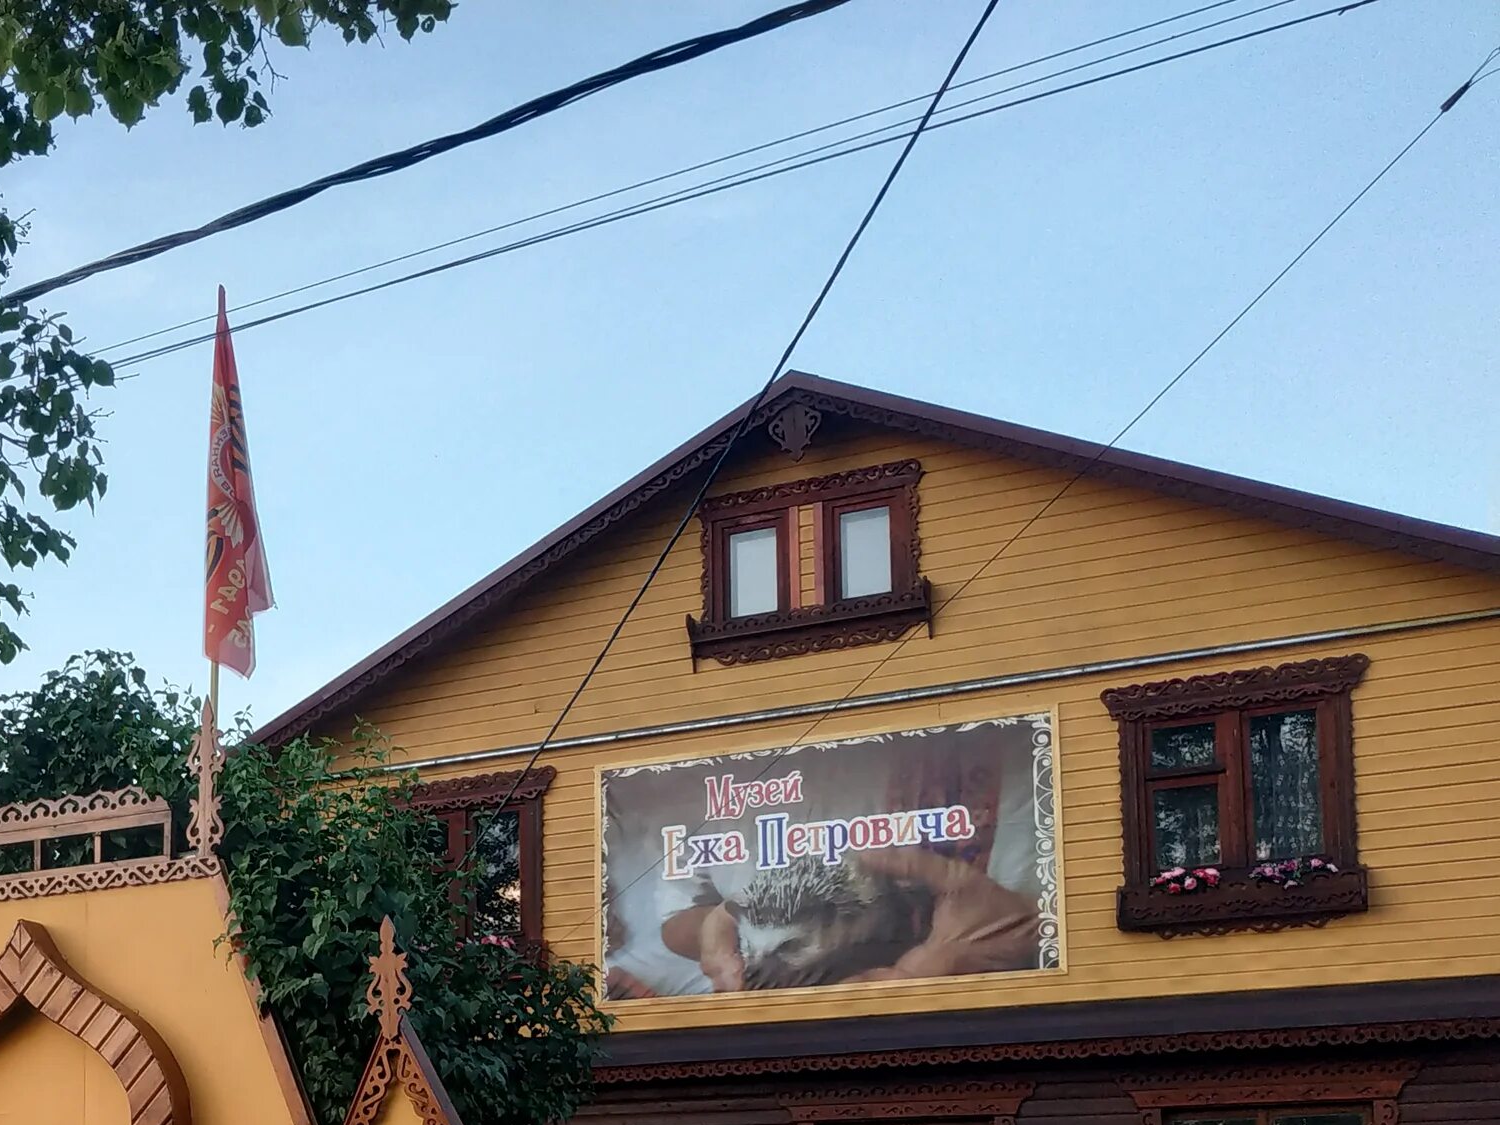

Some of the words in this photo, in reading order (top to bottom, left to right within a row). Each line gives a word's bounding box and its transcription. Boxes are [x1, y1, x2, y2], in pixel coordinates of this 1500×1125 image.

[705, 770, 803, 821] Музей
[662, 825, 749, 881] Ежа
[756, 804, 974, 870] Петровича
